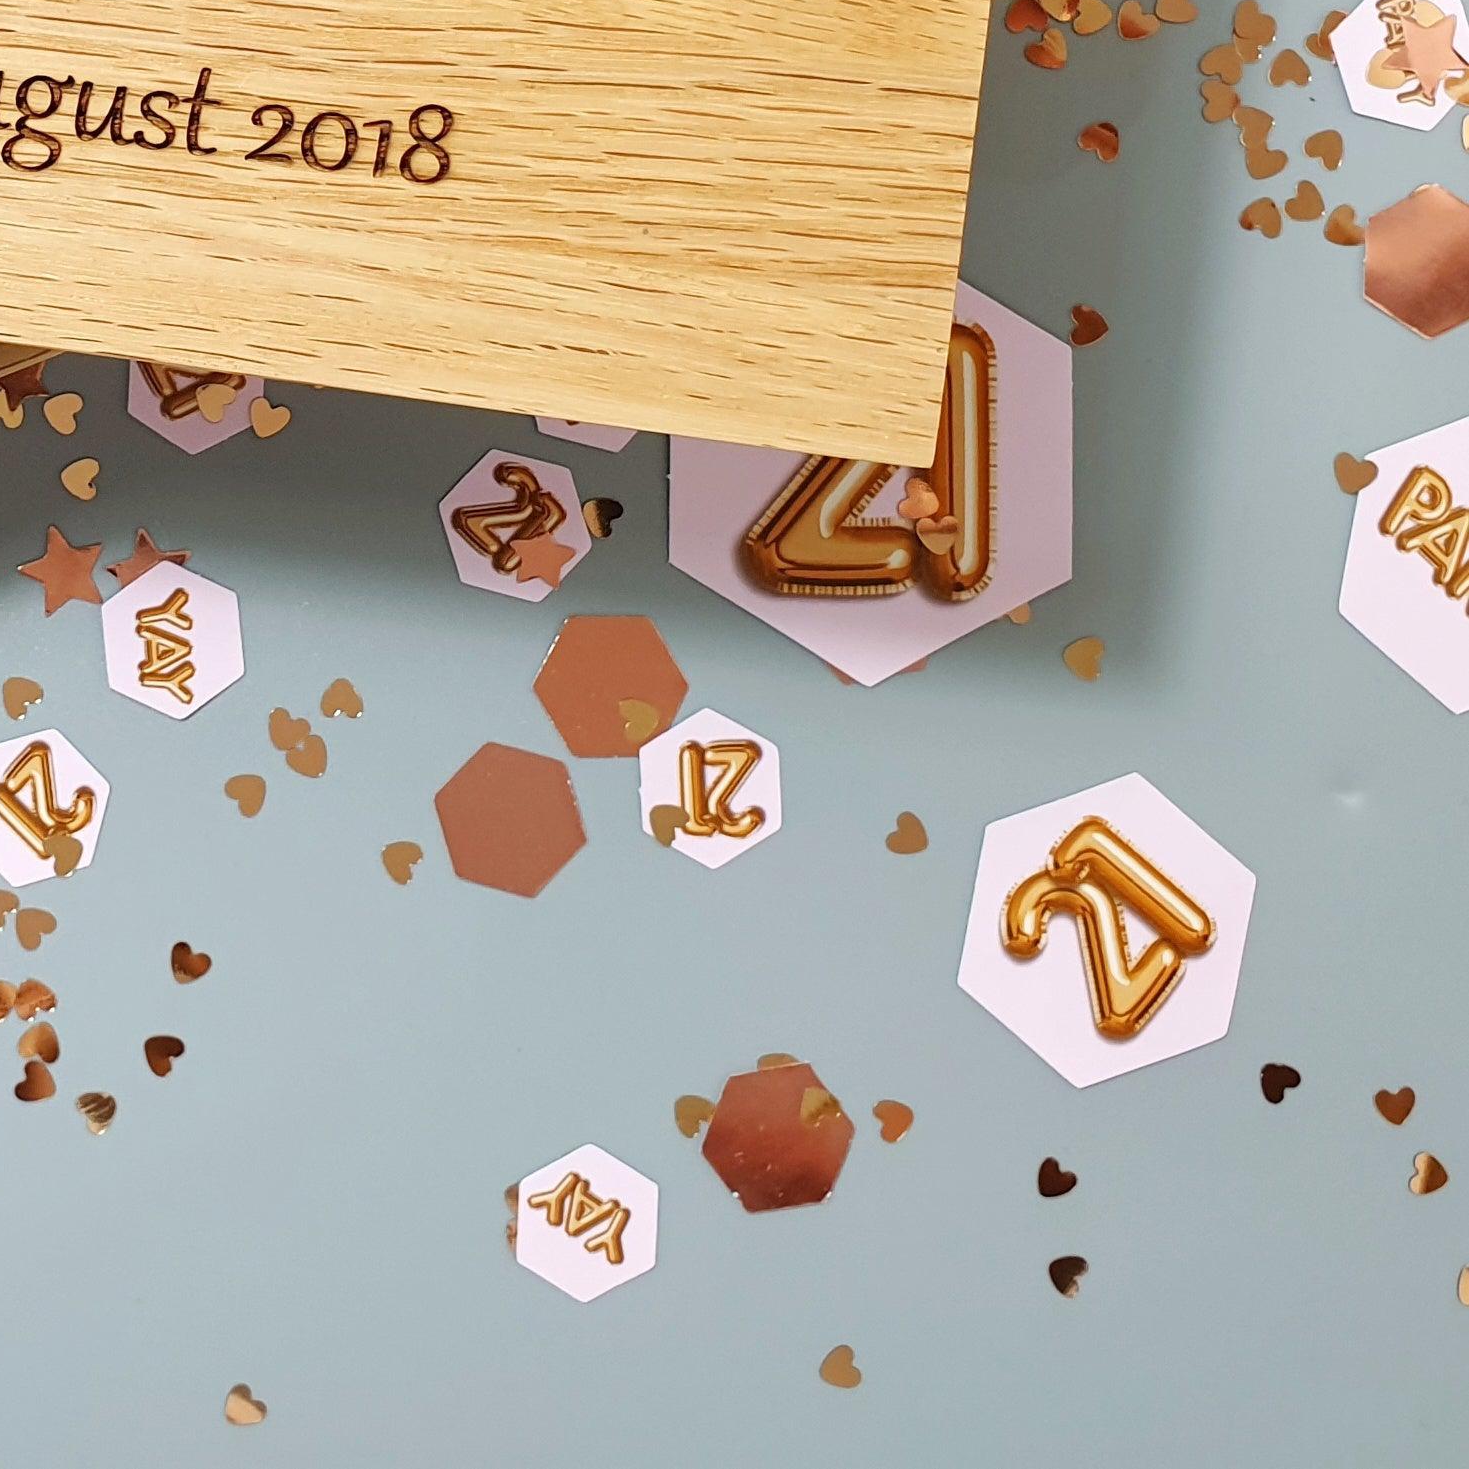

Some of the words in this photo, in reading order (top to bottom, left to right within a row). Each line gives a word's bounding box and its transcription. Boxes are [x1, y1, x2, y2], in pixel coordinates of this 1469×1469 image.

[242, 103, 456, 185] 2018
[135, 587, 194, 705] YAY
[678, 739, 764, 838] 21
[999, 814, 1218, 1043] 21
[527, 1171, 631, 1265] YAY
